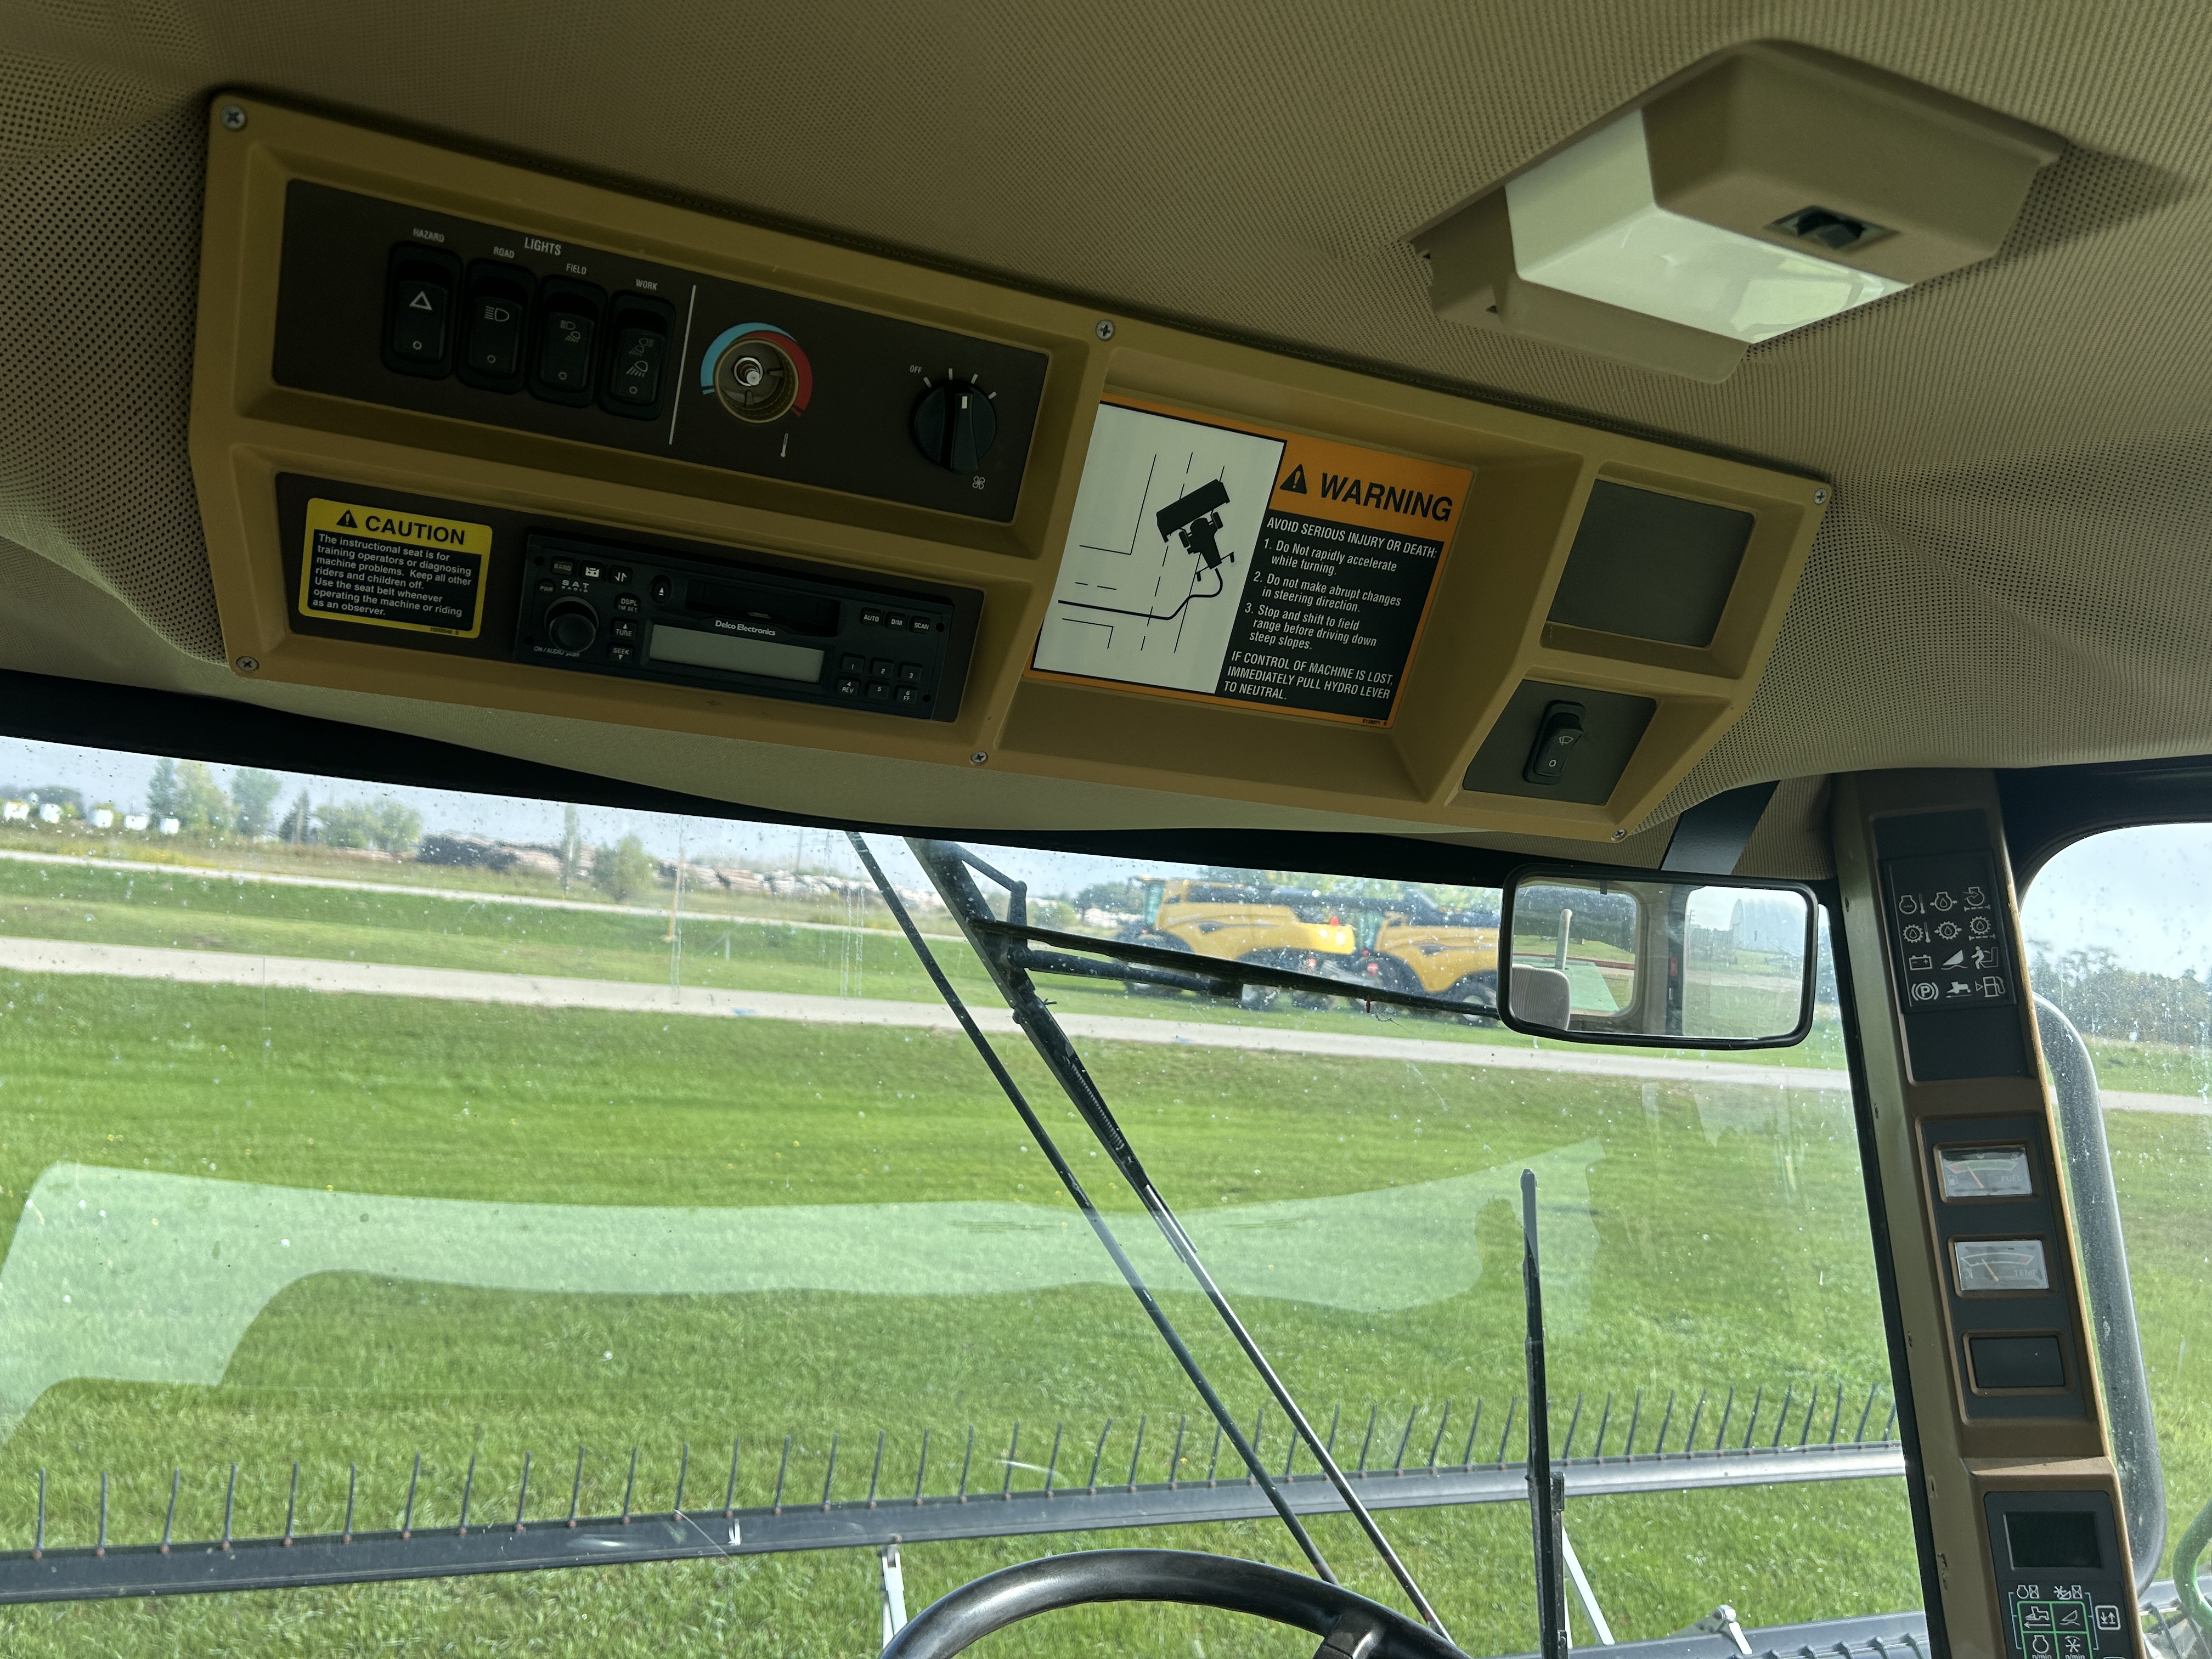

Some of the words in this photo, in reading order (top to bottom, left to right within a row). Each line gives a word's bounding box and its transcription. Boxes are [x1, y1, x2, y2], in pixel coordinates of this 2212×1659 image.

[413, 228, 445, 242] HAZARD
[524, 237, 561, 256] LIGHTS
[493, 246, 515, 258] ROAD
[566, 263, 587, 275] FIELD
[636, 278, 658, 291] WORK
[910, 364, 922, 374] OFF
[1321, 472, 1453, 522] WARNING
[365, 516, 465, 545] CAUTION
[1267, 517, 1299, 533] AVOID
[1301, 522, 1346, 542] SERIOUS
[1347, 531, 1385, 549] INJURY
[1386, 539, 1401, 552] OR
[1402, 542, 1437, 558] DEATH:
[319, 533, 337, 544] The
[340, 535, 400, 554] instructional
[403, 546, 423, 557] seat
[426, 550, 433, 558] is
[437, 551, 450, 561] for
[1264, 538, 1272, 549] 1.
[1276, 540, 1289, 552] Do
[1292, 543, 1308, 556] Not
[1311, 548, 1346, 565] rapidly
[1347, 554, 1397, 572] accelerate
[316, 557, 356, 569] machine
[358, 563, 404, 576] problems.
[409, 569, 433, 582] Keep
[435, 573, 445, 582] all
[448, 575, 472, 586] other
[317, 545, 356, 559] training
[357, 552, 404, 566] operators
[419, 561, 472, 577] diagnosing
[554, 563, 571, 571] BAND
[1271, 554, 1298, 568] while
[1300, 558, 1337, 576] turning.
[314, 577, 334, 586] Use
[336, 580, 352, 590] the
[354, 584, 374, 593] seat
[377, 586, 395, 596] belt
[397, 589, 443, 603] whenever
[315, 567, 344, 578] riders
[346, 571, 365, 581] and
[367, 574, 406, 587] children
[409, 580, 424, 590] off.
[562, 579, 589, 589] SAT
[1253, 571, 1262, 583] 2.
[1267, 573, 1279, 585] Do
[1283, 577, 1299, 589] not
[1300, 581, 1327, 593] make
[1329, 584, 1361, 600] abrupt
[1362, 590, 1401, 606] changes
[313, 589, 360, 603] operating
[363, 594, 377, 604] the
[380, 598, 420, 610] machine
[435, 606, 462, 618] riding
[313, 599, 324, 607] as
[341, 603, 386, 616] observer.
[621, 598, 637, 606] DSPL
[1262, 586, 1272, 597] in
[1274, 589, 1313, 607] steering
[1316, 596, 1360, 613] direction.
[715, 620, 736, 629] Delco
[737, 624, 776, 636] Electronics
[1245, 602, 1254, 614] 3.
[1258, 604, 1279, 619] Stop
[1282, 610, 1301, 622] and
[1302, 613, 1324, 625] shift
[1326, 616, 1335, 627] to
[1338, 617, 1360, 631] field
[616, 628, 633, 636] TUNE
[1249, 631, 1276, 645] steep
[1278, 635, 1312, 650] slopes.
[1253, 619, 1281, 633] range
[1283, 622, 1314, 636] before
[1317, 628, 1349, 644] driving
[1351, 635, 1377, 647] down
[1231, 651, 1242, 661] IF
[1244, 652, 1290, 669] CONTROL
[1294, 660, 1307, 671] OF
[1308, 663, 1355, 679] MACHINE
[1355, 669, 1366, 681] IS
[1368, 672, 1393, 686] LOST,
[1223, 680, 1238, 692] TO
[1239, 683, 1286, 700] NEUTRAL.
[1227, 666, 1295, 685] IMMEDIATELY
[1296, 676, 1321, 690] PULL
[1324, 680, 1358, 695] HYDRO
[1360, 685, 1390, 699] LEVER
